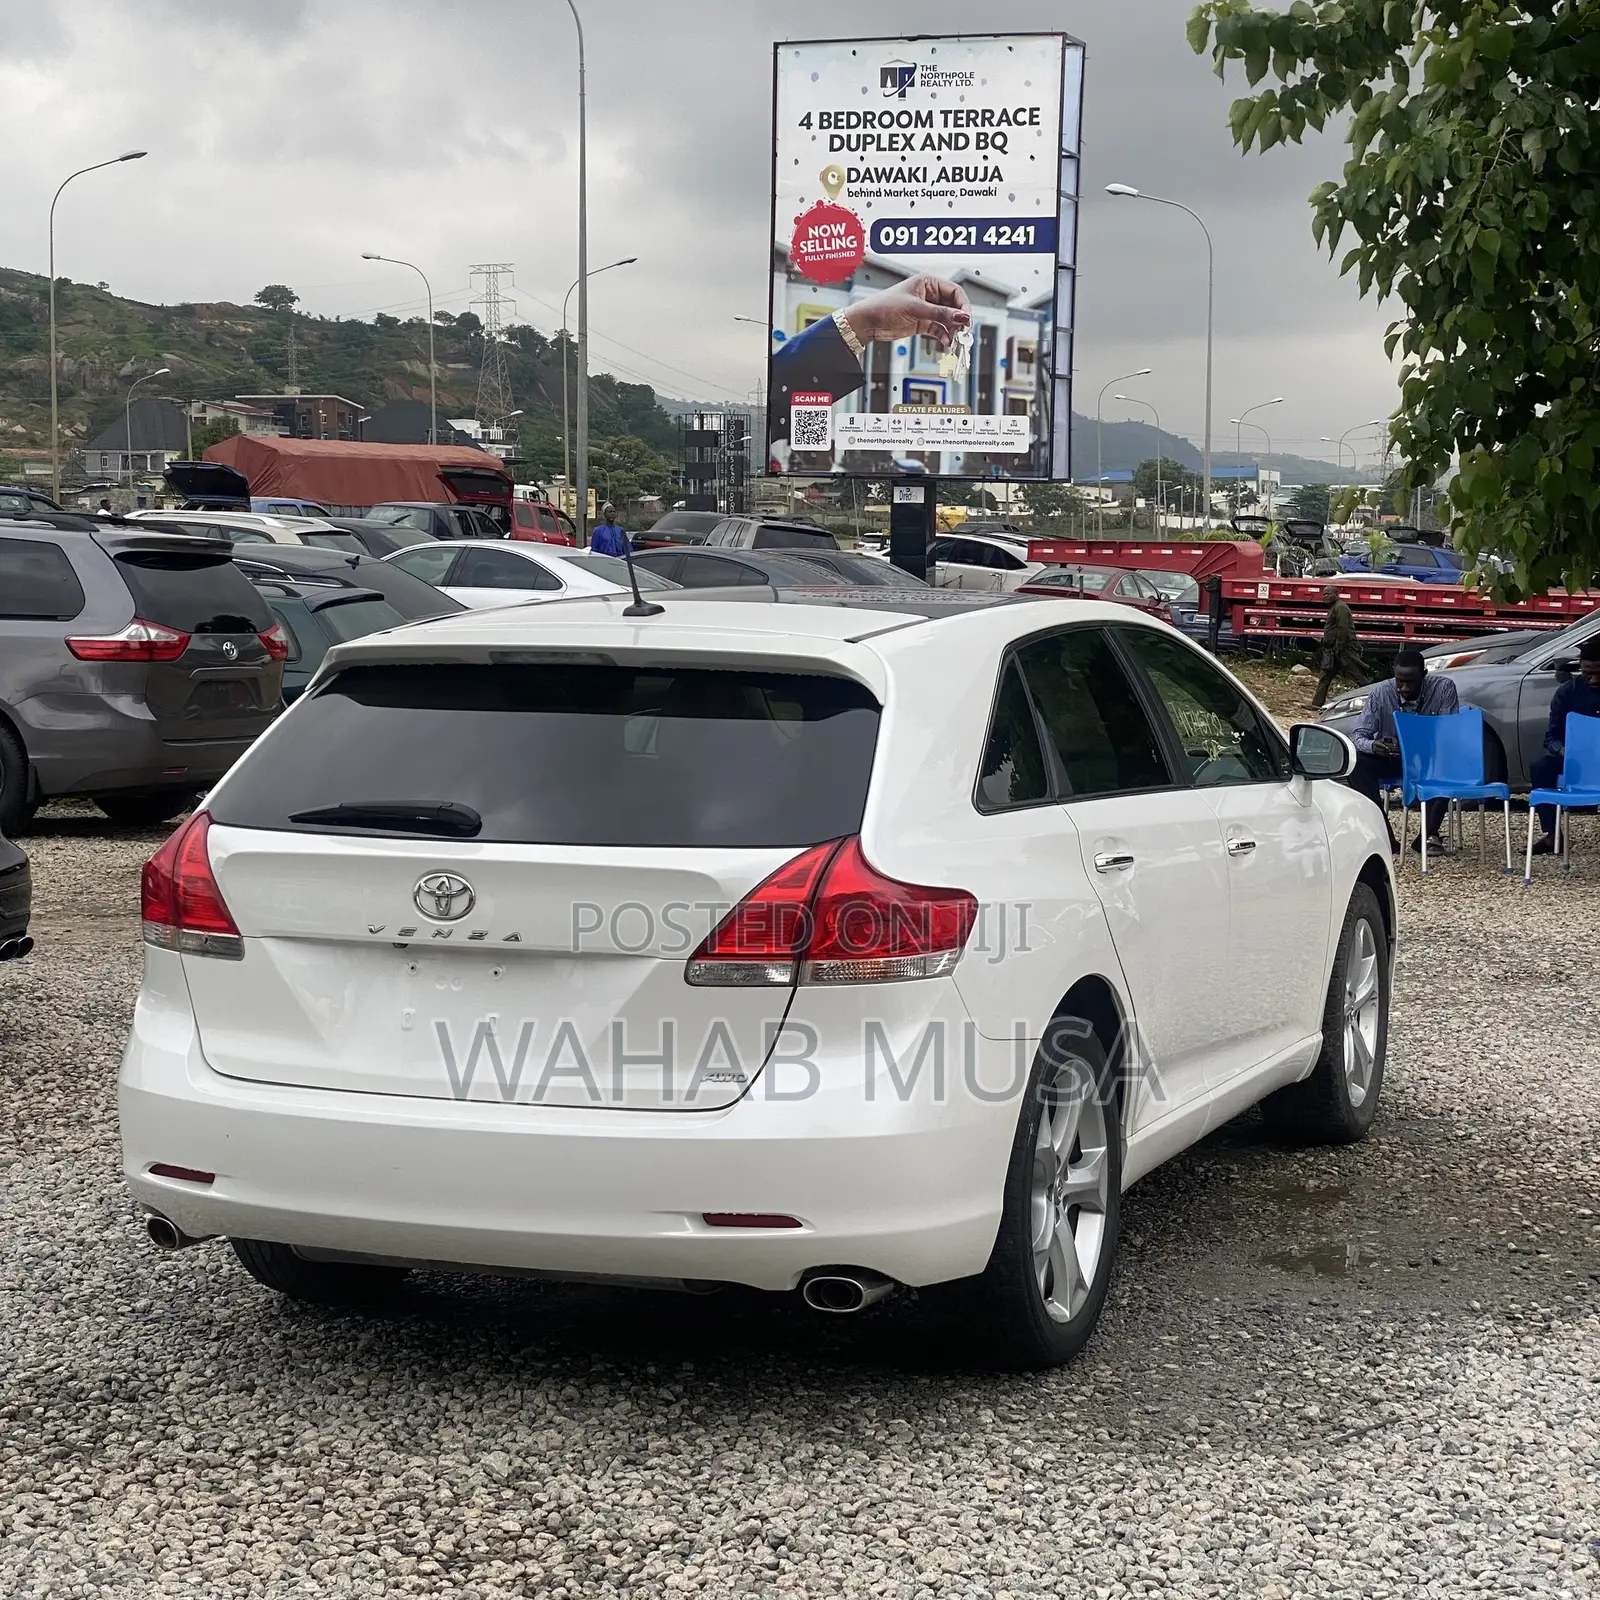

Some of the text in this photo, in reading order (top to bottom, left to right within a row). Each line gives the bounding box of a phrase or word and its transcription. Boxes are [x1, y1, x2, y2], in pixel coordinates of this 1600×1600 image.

[798, 107, 1041, 130] 4 BEDROOM TERRACE
[829, 131, 1009, 155] DUPLEX AND BQ
[846, 166, 928, 183] DAWAKI
[847, 186, 998, 200] behind Market Square, Dawaki
[808, 222, 847, 239] NOW
[879, 225, 1035, 247] 091 2021 4241
[799, 235, 858, 254] SELLING
[804, 250, 856, 262] FULLY FINISHED
[794, 395, 830, 403] SCAN ME
[927, 406, 966, 414] FEATURES
[857, 437, 1015, 447] thenorthpolerealty www.thenorthpolerealty.com
[367, 924, 523, 942] VENZA
